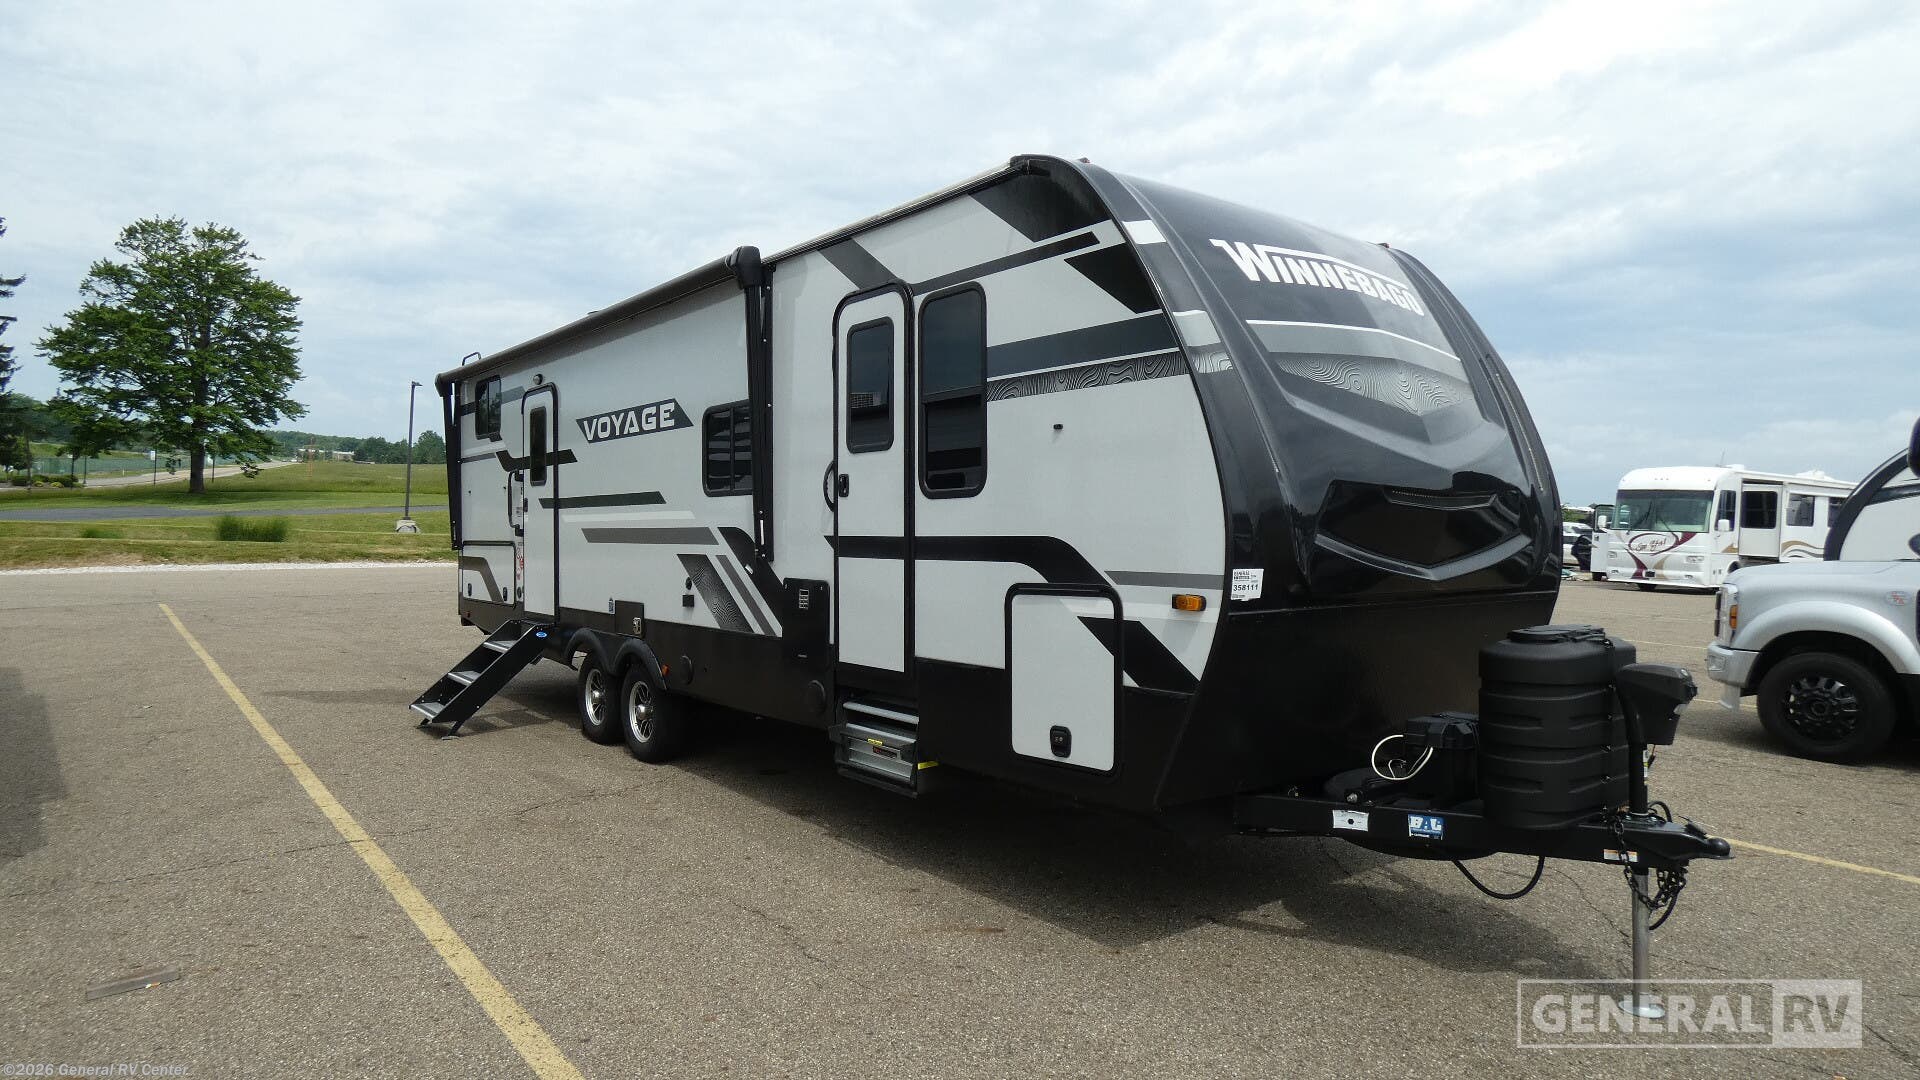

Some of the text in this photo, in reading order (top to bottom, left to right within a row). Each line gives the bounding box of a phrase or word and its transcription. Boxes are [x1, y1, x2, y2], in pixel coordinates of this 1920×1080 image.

[1209, 238, 1424, 316] WINNEBAGO
[583, 402, 675, 441] VOYAGE
[1232, 584, 1258, 592] 358111
